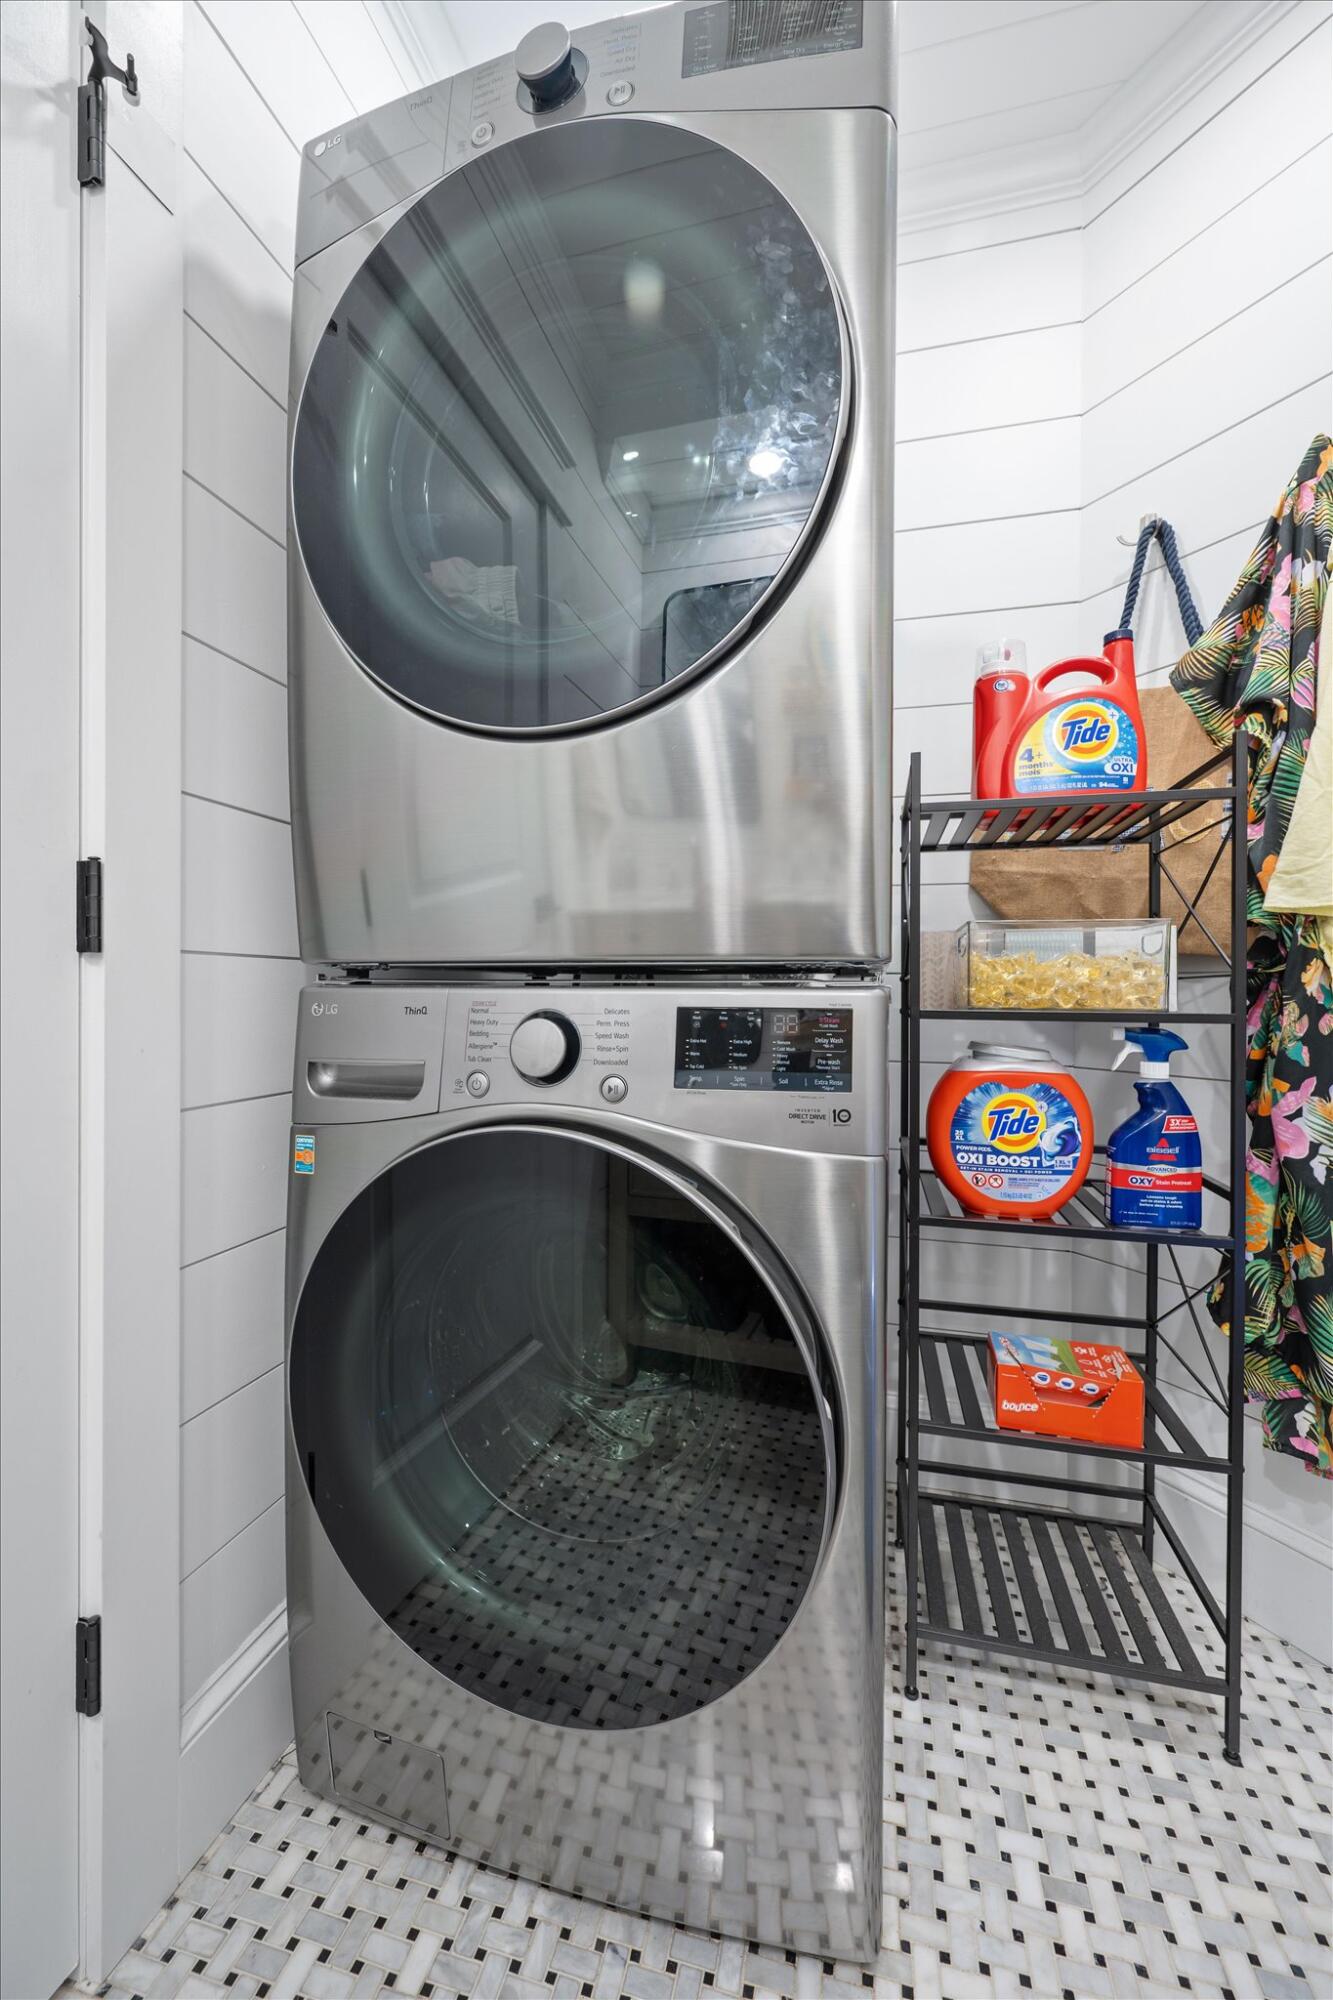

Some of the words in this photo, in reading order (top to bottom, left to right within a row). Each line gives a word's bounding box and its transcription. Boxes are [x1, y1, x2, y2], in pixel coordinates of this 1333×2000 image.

[327, 134, 341, 149] LG
[1062, 717, 1111, 751] Tide
[1111, 762, 1133, 773] OXI
[325, 1003, 339, 1015] LG
[404, 1006, 428, 1015] ThinQ
[814, 1037, 829, 1045] Delay
[596, 1045, 629, 1053] Rinse+Spin
[988, 1107, 1040, 1141] Tide
[1169, 1118, 1182, 1126] 3X
[956, 1151, 983, 1164] OXI
[986, 1154, 1040, 1167] BOOST
[1129, 1176, 1153, 1186] OXY
[1001, 1400, 1039, 1412] bounce
